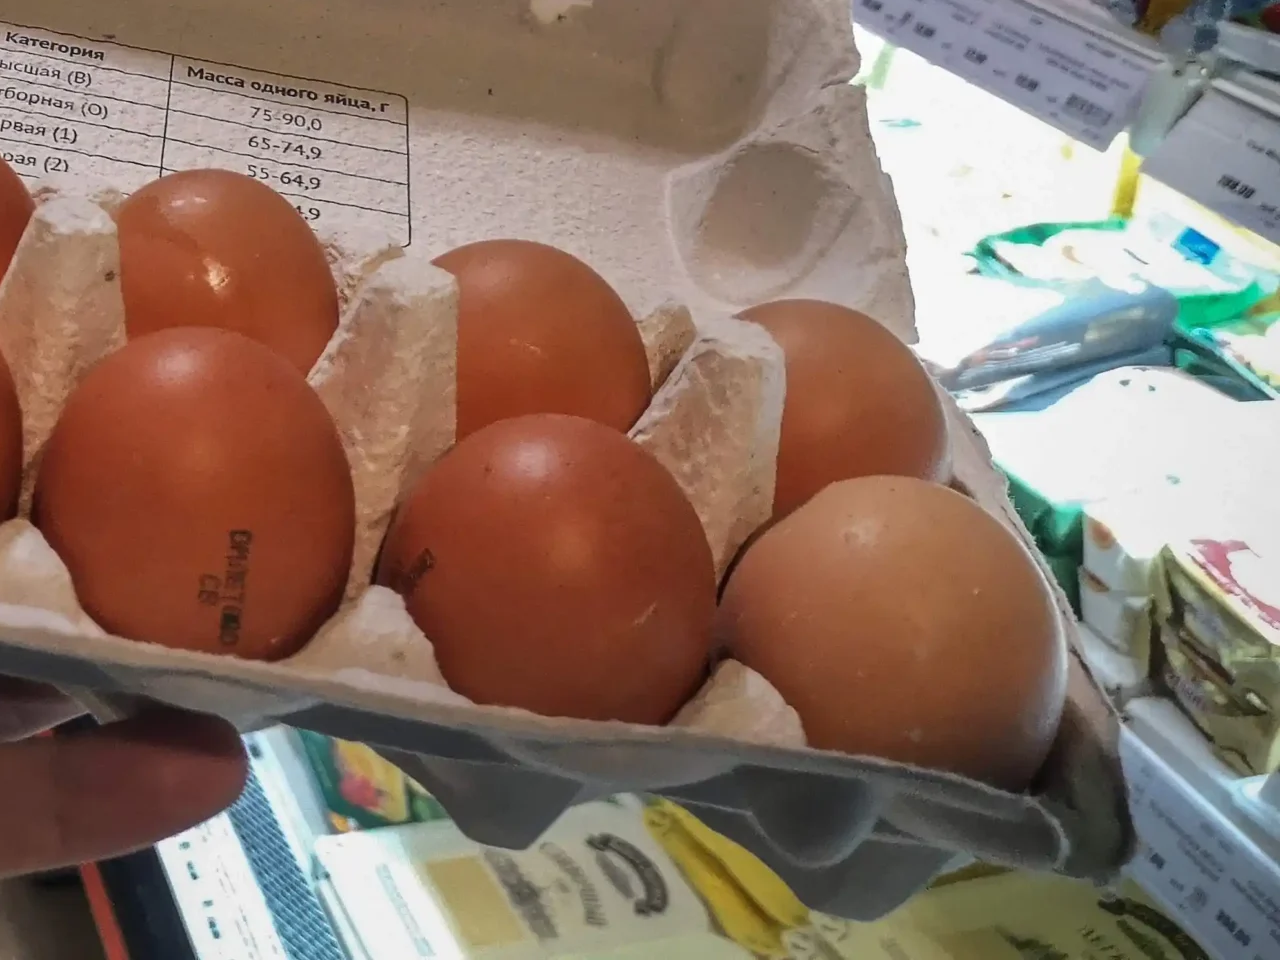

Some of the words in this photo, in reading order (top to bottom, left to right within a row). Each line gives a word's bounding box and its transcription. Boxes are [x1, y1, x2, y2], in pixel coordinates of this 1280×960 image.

[6, 32, 104, 61] Категория
[67, 71, 92, 88] (В)
[187, 66, 245, 88] Масса
[251, 82, 318, 100] одного
[324, 94, 376, 112] яйца,
[380, 102, 390, 113] г
[249, 106, 323, 131] 75-90,0
[53, 127, 78, 144] (1)
[248, 136, 322, 159] 65-74,9
[0, 152, 36, 166] рая
[44, 156, 68, 173] (2)
[247, 165, 321, 191] 55-64,9
